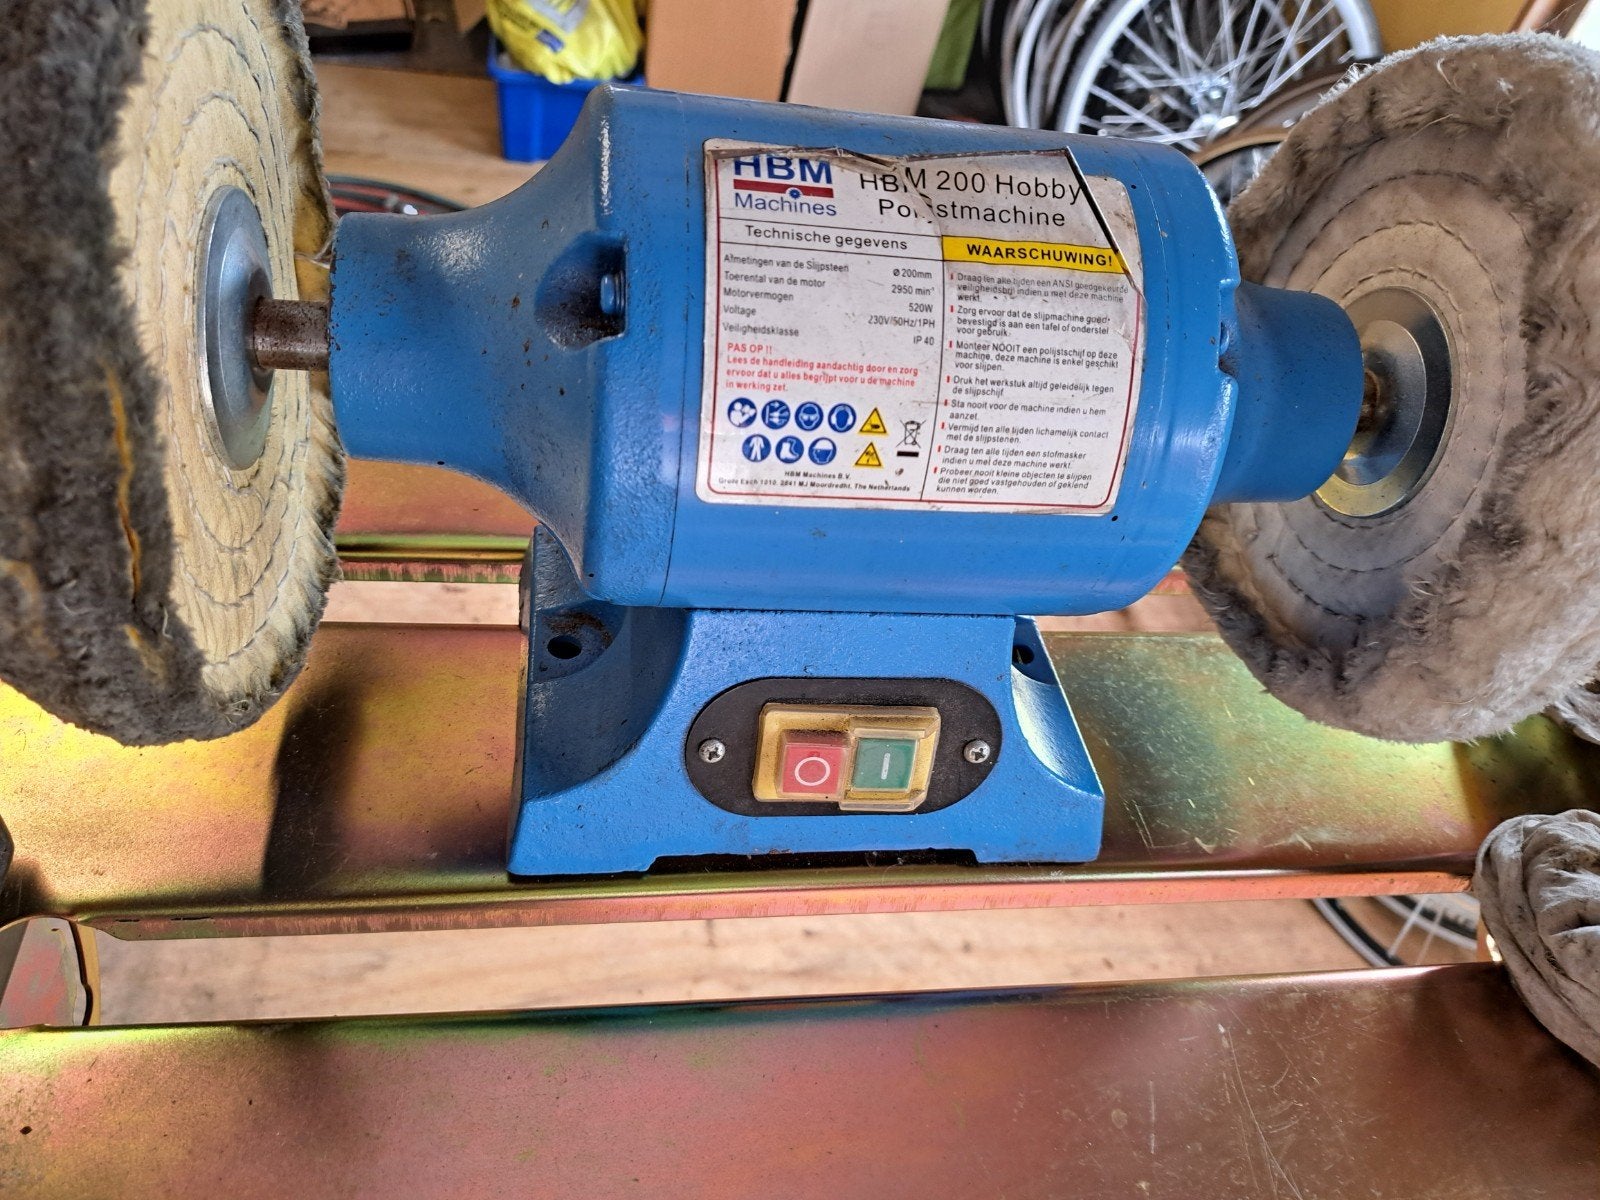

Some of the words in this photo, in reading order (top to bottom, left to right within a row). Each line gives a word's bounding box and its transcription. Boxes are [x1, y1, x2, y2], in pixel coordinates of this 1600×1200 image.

[734, 155, 832, 184] HBM
[860, 167, 926, 192] HBM
[936, 171, 986, 193] 200
[996, 174, 1080, 205] Hobby
[735, 193, 837, 216] Machines
[745, 225, 830, 243] Technische
[835, 236, 908, 250] gegevens
[967, 244, 1112, 266] WAARSCHUWING!
[724, 254, 774, 268] Afmetingen
[793, 260, 804, 268] de
[806, 260, 849, 272] Slijpsteen
[725, 271, 766, 283] Toerental
[957, 273, 981, 284] Draag
[984, 275, 995, 283] ten
[1013, 277, 1035, 287] tijden
[1052, 280, 1073, 288] ANSI
[1075, 283, 1128, 293] goedgekeurde
[723, 287, 794, 303] Motorvermogen
[891, 284, 913, 294] 2950
[1017, 288, 1041, 296] indien
[1069, 291, 1089, 299] deze
[1091, 293, 1123, 303] machine
[723, 305, 756, 317] Voltage
[909, 303, 933, 313] 520W
[957, 305, 976, 316] Zorg
[1022, 310, 1032, 318] de
[1034, 312, 1084, 322] slijpmachine
[722, 322, 799, 336] Veiligheidsklasse
[868, 315, 935, 328] 230V/50Hz/1PH
[957, 316, 997, 327] bevestigd
[999, 319, 1006, 327] is
[1042, 322, 1060, 331] tafel
[1062, 324, 1070, 332] of
[1071, 325, 1109, 334] onderstel
[727, 343, 747, 352] PAS
[749, 344, 763, 353] OP
[913, 336, 922, 345] IP
[924, 336, 935, 345] 40
[956, 341, 990, 350] Monteer
[1040, 347, 1085, 358] polijstschijf
[1087, 351, 1096, 359] op
[1098, 351, 1118, 359] deze
[727, 355, 747, 364] Lees
[750, 356, 760, 365] de
[763, 357, 814, 370] handleiding
[816, 362, 864, 373] aandachtig
[866, 364, 885, 373] door
[900, 367, 918, 376] zorg
[995, 353, 1015, 362] deze
[1017, 355, 1051, 364] machine
[1062, 358, 1083, 366] enkel
[1085, 360, 1118, 368] geschikt
[727, 369, 755, 377] ervoor
[757, 369, 771, 378] dat
[781, 372, 801, 380] alles
[803, 373, 837, 383] begrijpt
[880, 378, 915, 387] machine
[953, 376, 973, 384] Druk
[975, 377, 988, 385] het
[990, 379, 1026, 388] werkstuk
[1028, 380, 1048, 390] altijd
[1050, 382, 1089, 393] geleidelijk
[1092, 385, 1114, 394] tegen
[736, 382, 770, 392] werking
[951, 399, 965, 408] Sta
[967, 401, 987, 409] nooit
[1021, 404, 1054, 412] machine
[949, 423, 979, 433] Vermijd
[1011, 427, 1034, 436] tijden
[1036, 427, 1077, 438] lichamelijk
[1080, 430, 1109, 438] contact
[963, 433, 974, 441] de
[944, 445, 969, 455] Draag
[971, 447, 984, 455] ten
[985, 447, 1000, 455] alle
[1002, 448, 1024, 457] tijden
[1042, 450, 1086, 459] stofmasker
[1014, 460, 1047, 468] machine
[803, 471, 835, 479] Machines
[940, 467, 972, 476] Probeer
[1021, 471, 1055, 480] objecten
[1066, 472, 1092, 481] slijpen
[969, 478, 989, 486] goed
[991, 479, 1046, 488] vastgehouden
